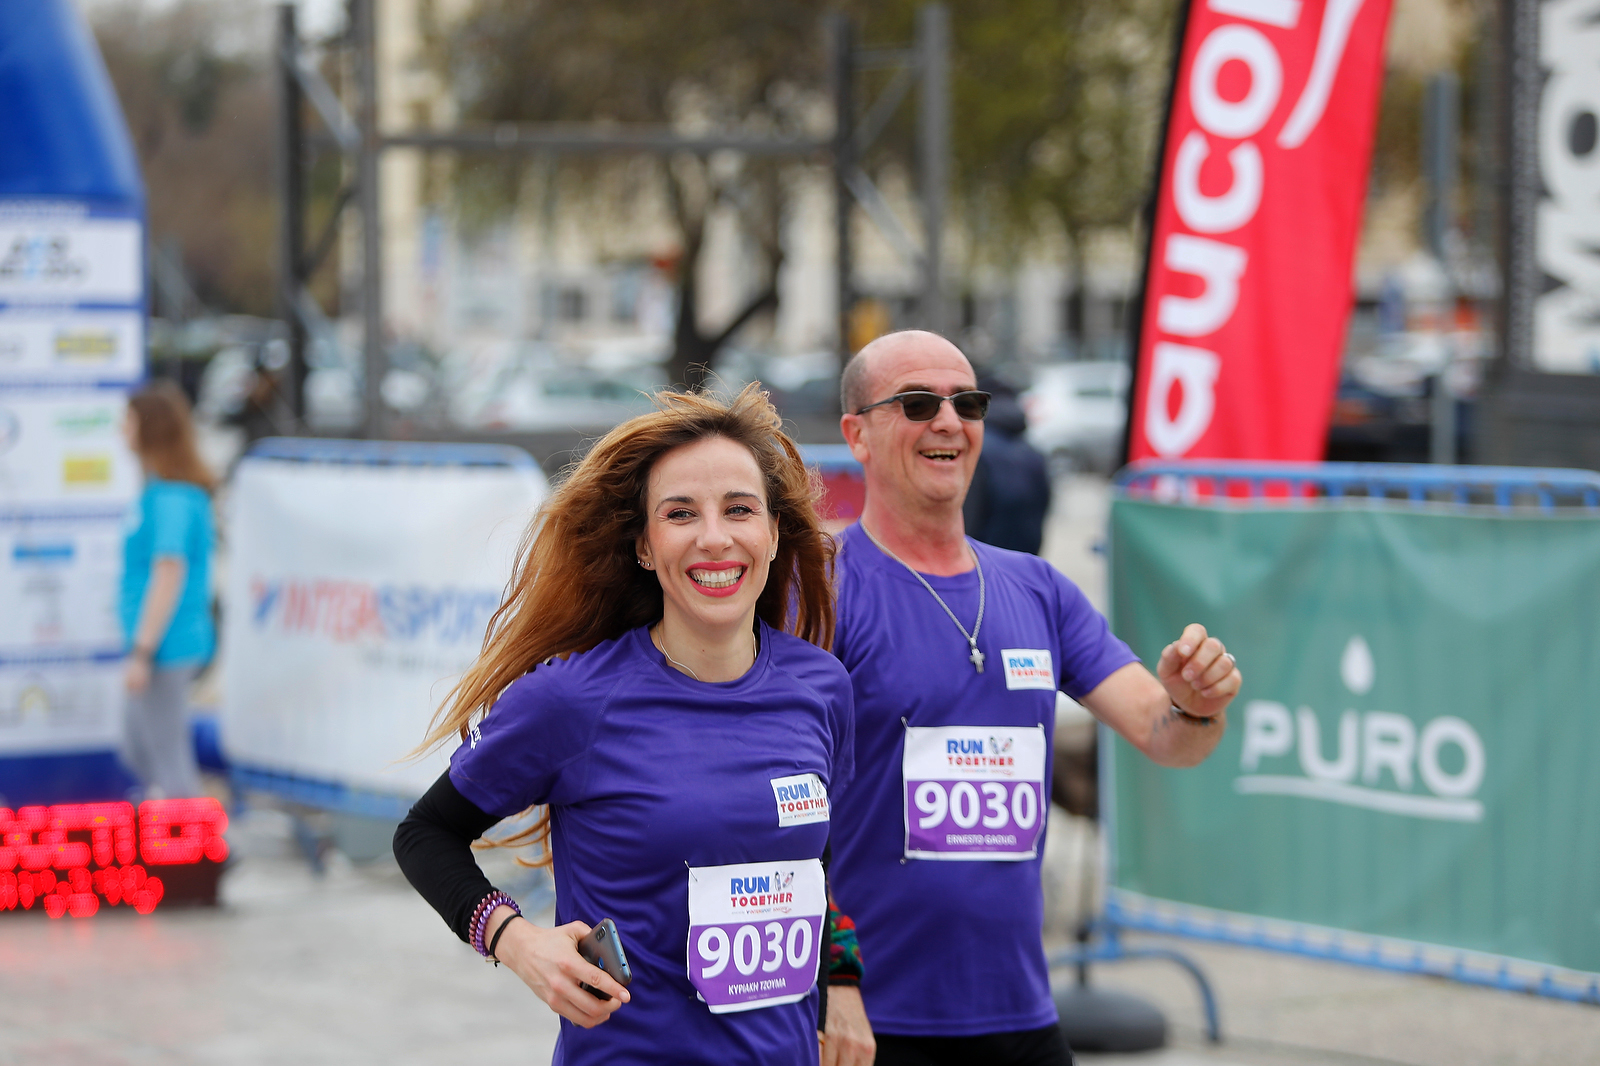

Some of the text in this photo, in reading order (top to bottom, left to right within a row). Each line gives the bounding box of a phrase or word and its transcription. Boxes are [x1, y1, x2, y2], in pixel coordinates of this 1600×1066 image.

[1009, 657, 1035, 668] RUN
[946, 739, 984, 754] RUN
[1240, 699, 1486, 798] PURO
[947, 756, 1014, 766] TOGETHER
[776, 782, 811, 802] RUN
[914, 781, 1038, 830] 9030
[946, 833, 984, 846] ERNESTO
[730, 875, 770, 895] RUN
[730, 892, 793, 908] TOGETHER
[697, 918, 813, 979] 9030
